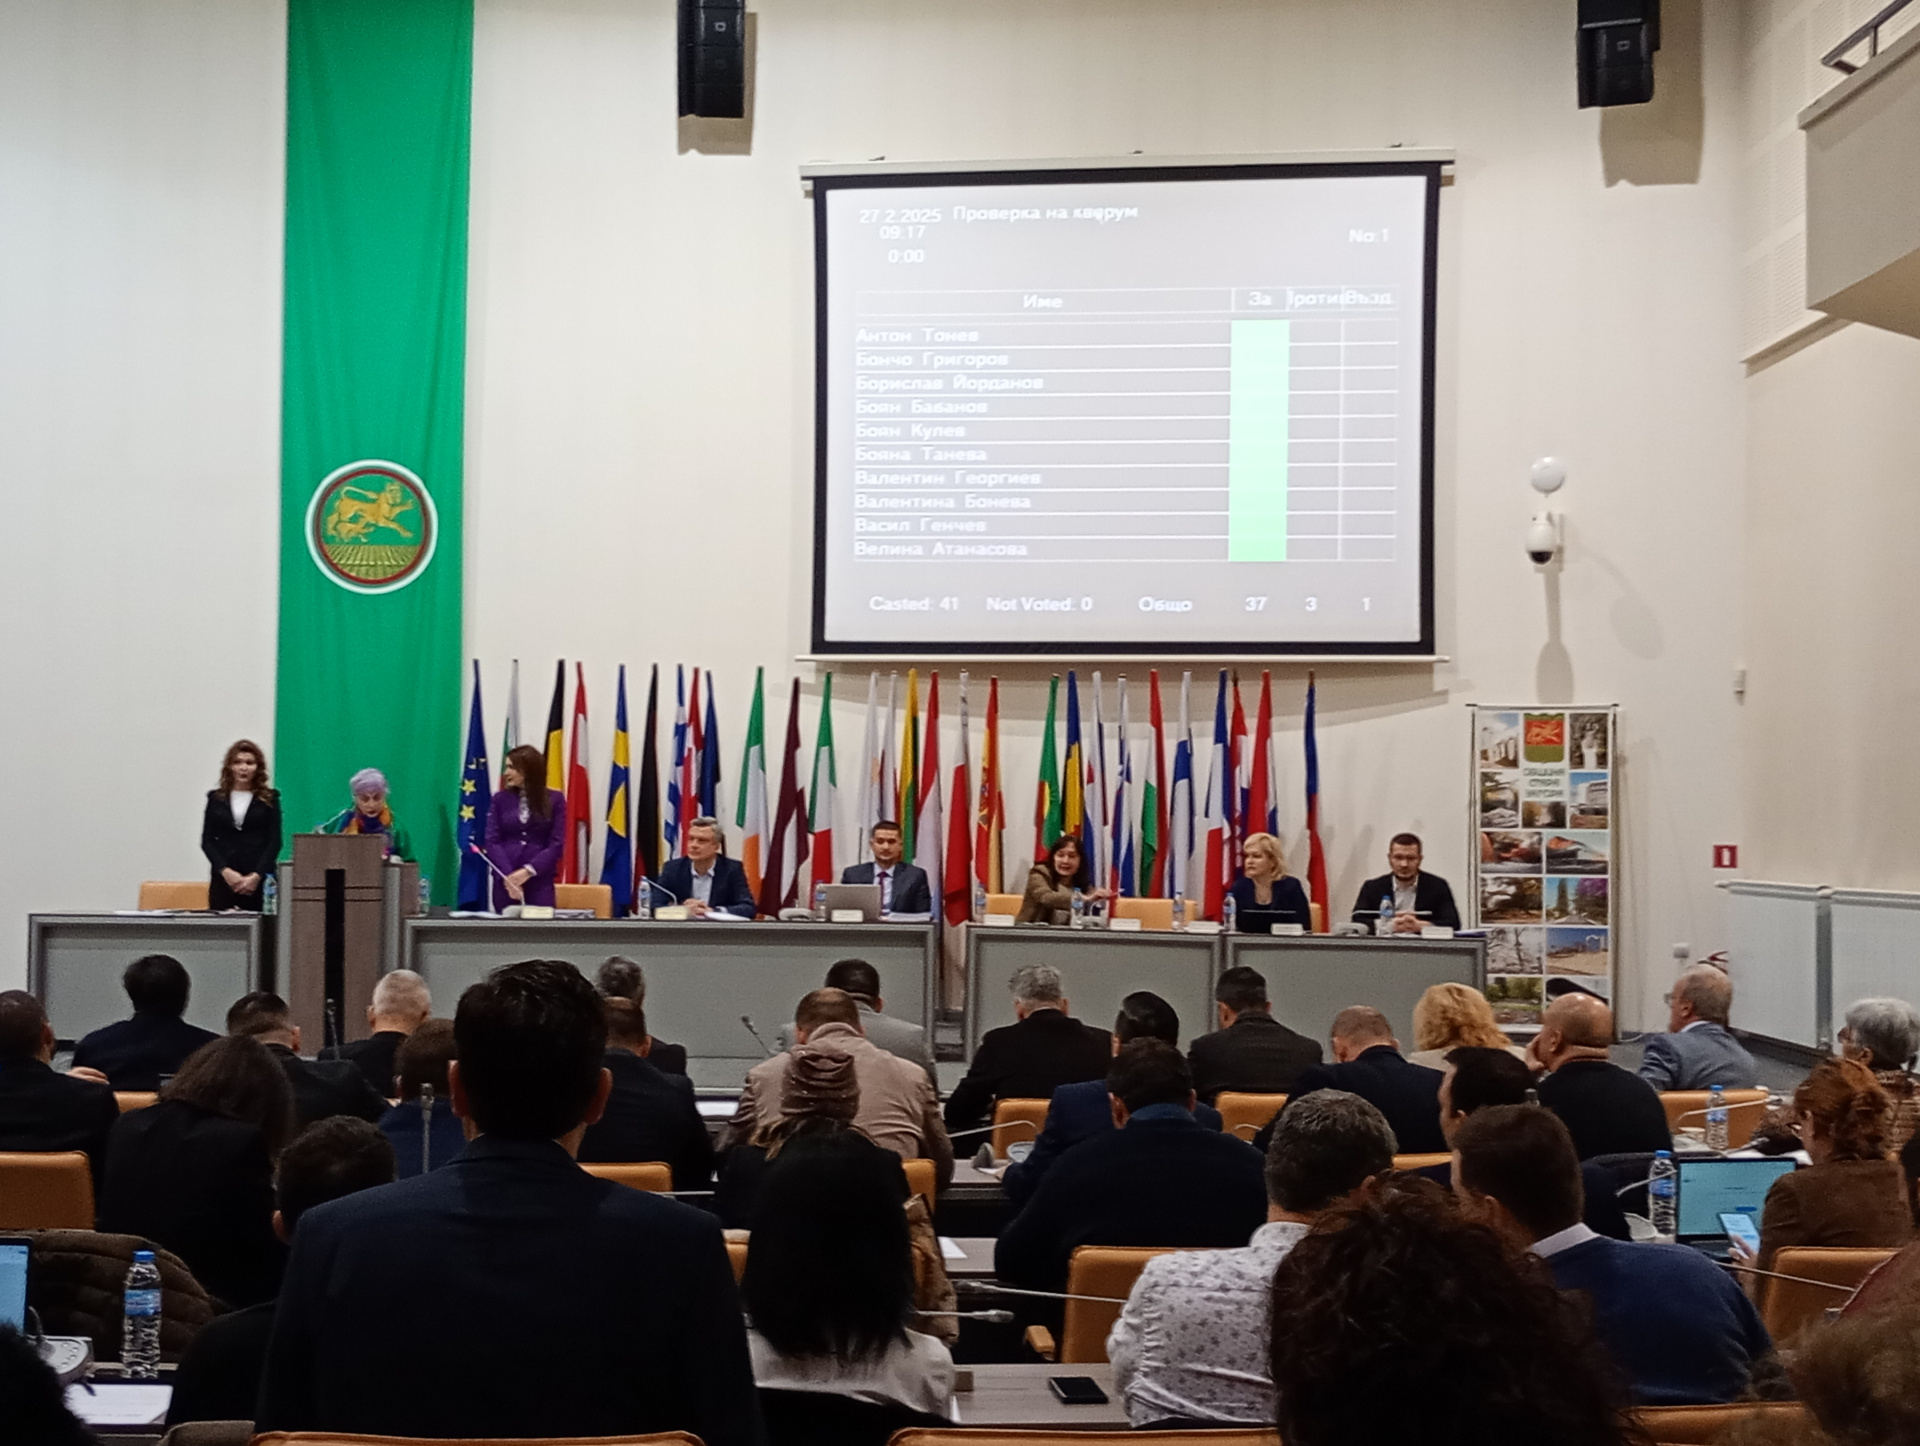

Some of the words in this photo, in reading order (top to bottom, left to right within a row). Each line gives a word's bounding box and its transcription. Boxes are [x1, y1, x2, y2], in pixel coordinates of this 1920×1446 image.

[953, 206, 1040, 223] Проверка
[1046, 208, 1068, 220] на
[879, 225, 926, 239] 09:17
[888, 249, 925, 263] 0:00
[1023, 294, 1063, 309] Име
[1248, 291, 1272, 306] За
[856, 327, 912, 342] Антон
[923, 327, 979, 342] Тонев
[856, 351, 913, 366] Бончо
[923, 351, 1009, 369] Григоров
[856, 375, 944, 392] Борислав
[953, 374, 1044, 392] Йорданов
[856, 399, 902, 414] Боян
[911, 399, 988, 414] Бабанов
[856, 423, 902, 437] Боян
[911, 423, 966, 440] Кулев
[855, 447, 911, 461] Бояна
[920, 446, 987, 461] Танева
[855, 470, 945, 485] Валентин
[954, 470, 1042, 487] Георгиев
[855, 494, 955, 509] Валентина
[965, 494, 1032, 509] Бонева
[855, 518, 911, 532] Васил
[920, 517, 987, 532] Генчев
[854, 541, 924, 556] Велина
[932, 541, 1028, 556] Атанасова
[869, 596, 933, 612] Casted:
[939, 596, 959, 611] 41
[986, 596, 1018, 611] Not
[1021, 596, 1075, 611] Voted:
[1081, 596, 1094, 611] 0
[1138, 596, 1193, 613] Общо
[1245, 596, 1268, 612] 37
[1306, 596, 1317, 612] 3
[1362, 596, 1371, 611] 1
